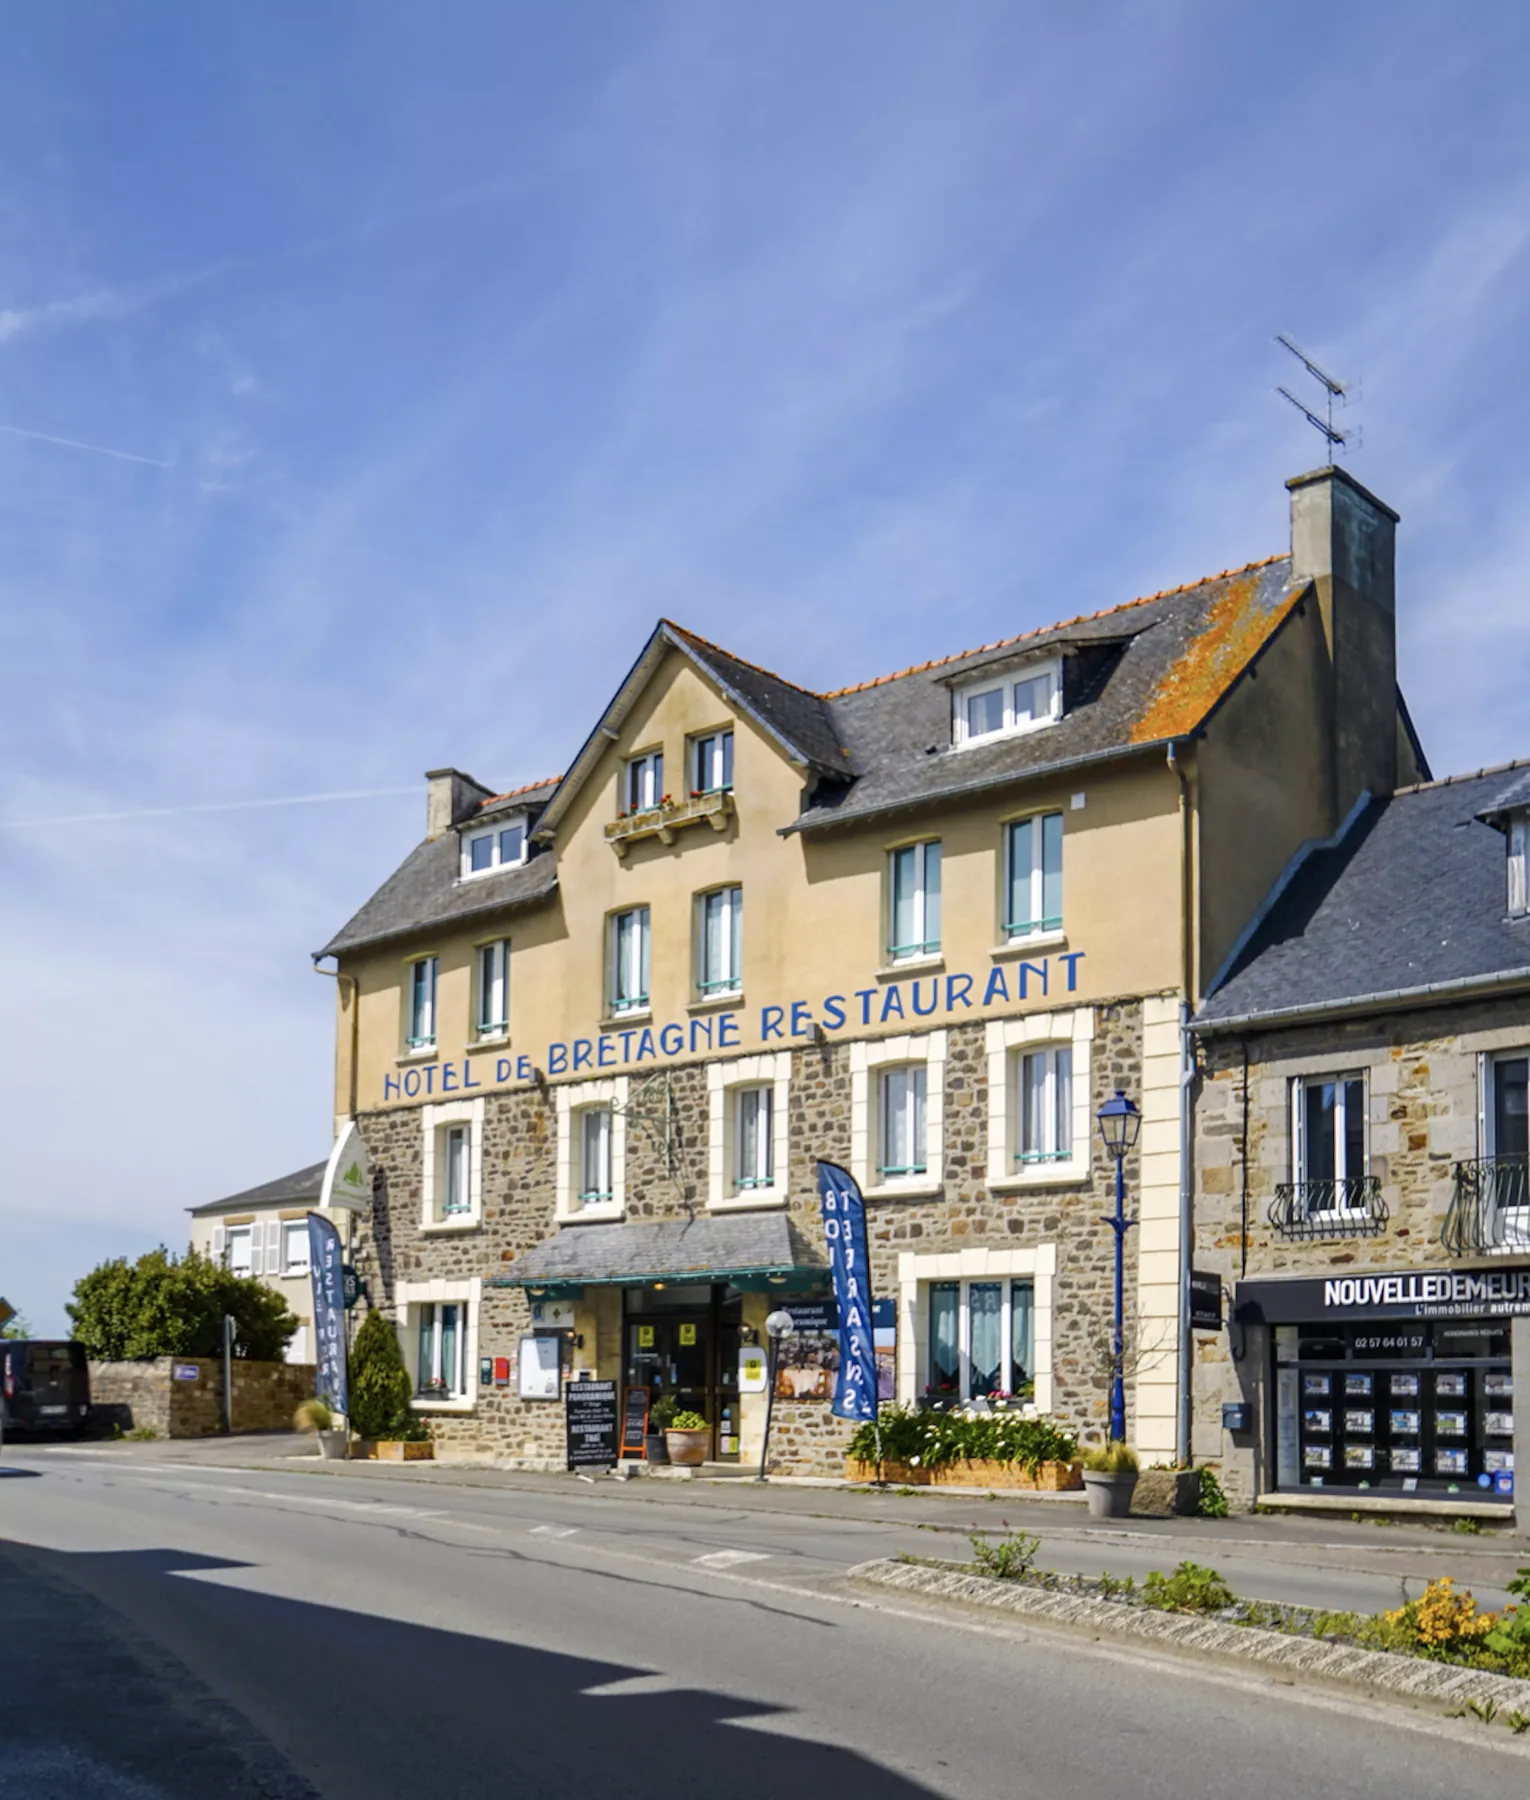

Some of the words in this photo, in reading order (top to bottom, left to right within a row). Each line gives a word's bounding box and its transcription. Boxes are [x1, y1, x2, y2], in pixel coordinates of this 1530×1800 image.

[384, 1058, 481, 1101] HOTEL
[496, 1055, 532, 1082] DE
[549, 1013, 741, 1075] BRETAGNE
[761, 951, 1086, 1042] RESTAURANT
[1415, 1303, 1485, 1316] L'immobilier
[1355, 1337, 1367, 1348] 02
[1369, 1337, 1381, 1348] 57
[1382, 1337, 1395, 1348] 64
[1397, 1336, 1408, 1347] 01
[1411, 1336, 1423, 1347] 57
